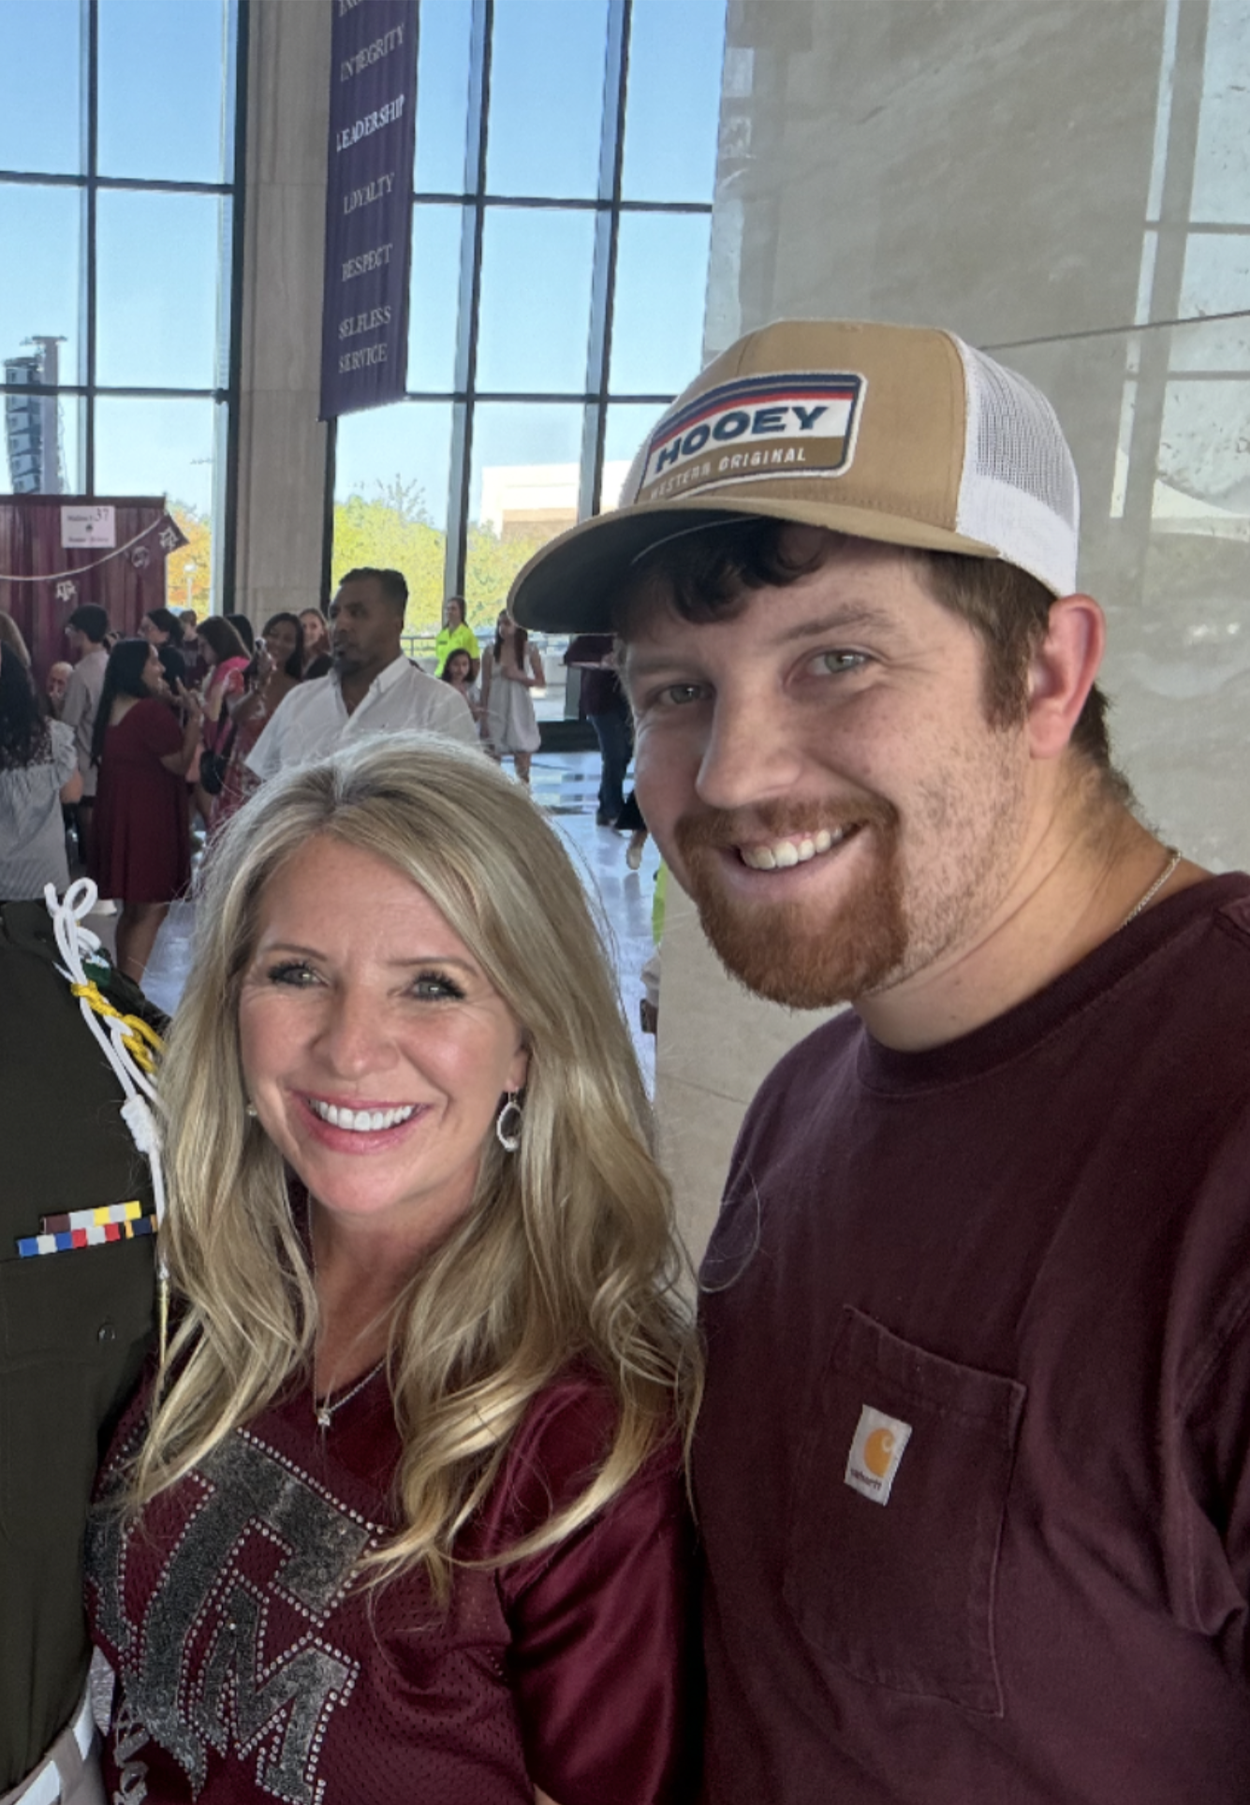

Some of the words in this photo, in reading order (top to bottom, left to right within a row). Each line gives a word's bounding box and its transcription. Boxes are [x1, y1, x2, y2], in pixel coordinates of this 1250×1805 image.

[340, 23, 405, 81] INTEGRITY
[336, 94, 405, 152] LEADERSHIP
[343, 172, 395, 214] LOYALTY
[342, 243, 393, 282] RESPECT
[338, 306, 391, 340] SELFLESS
[338, 343, 388, 373] SERVICE
[654, 405, 830, 475] HOOEY
[718, 447, 807, 473] ORIGINAL
